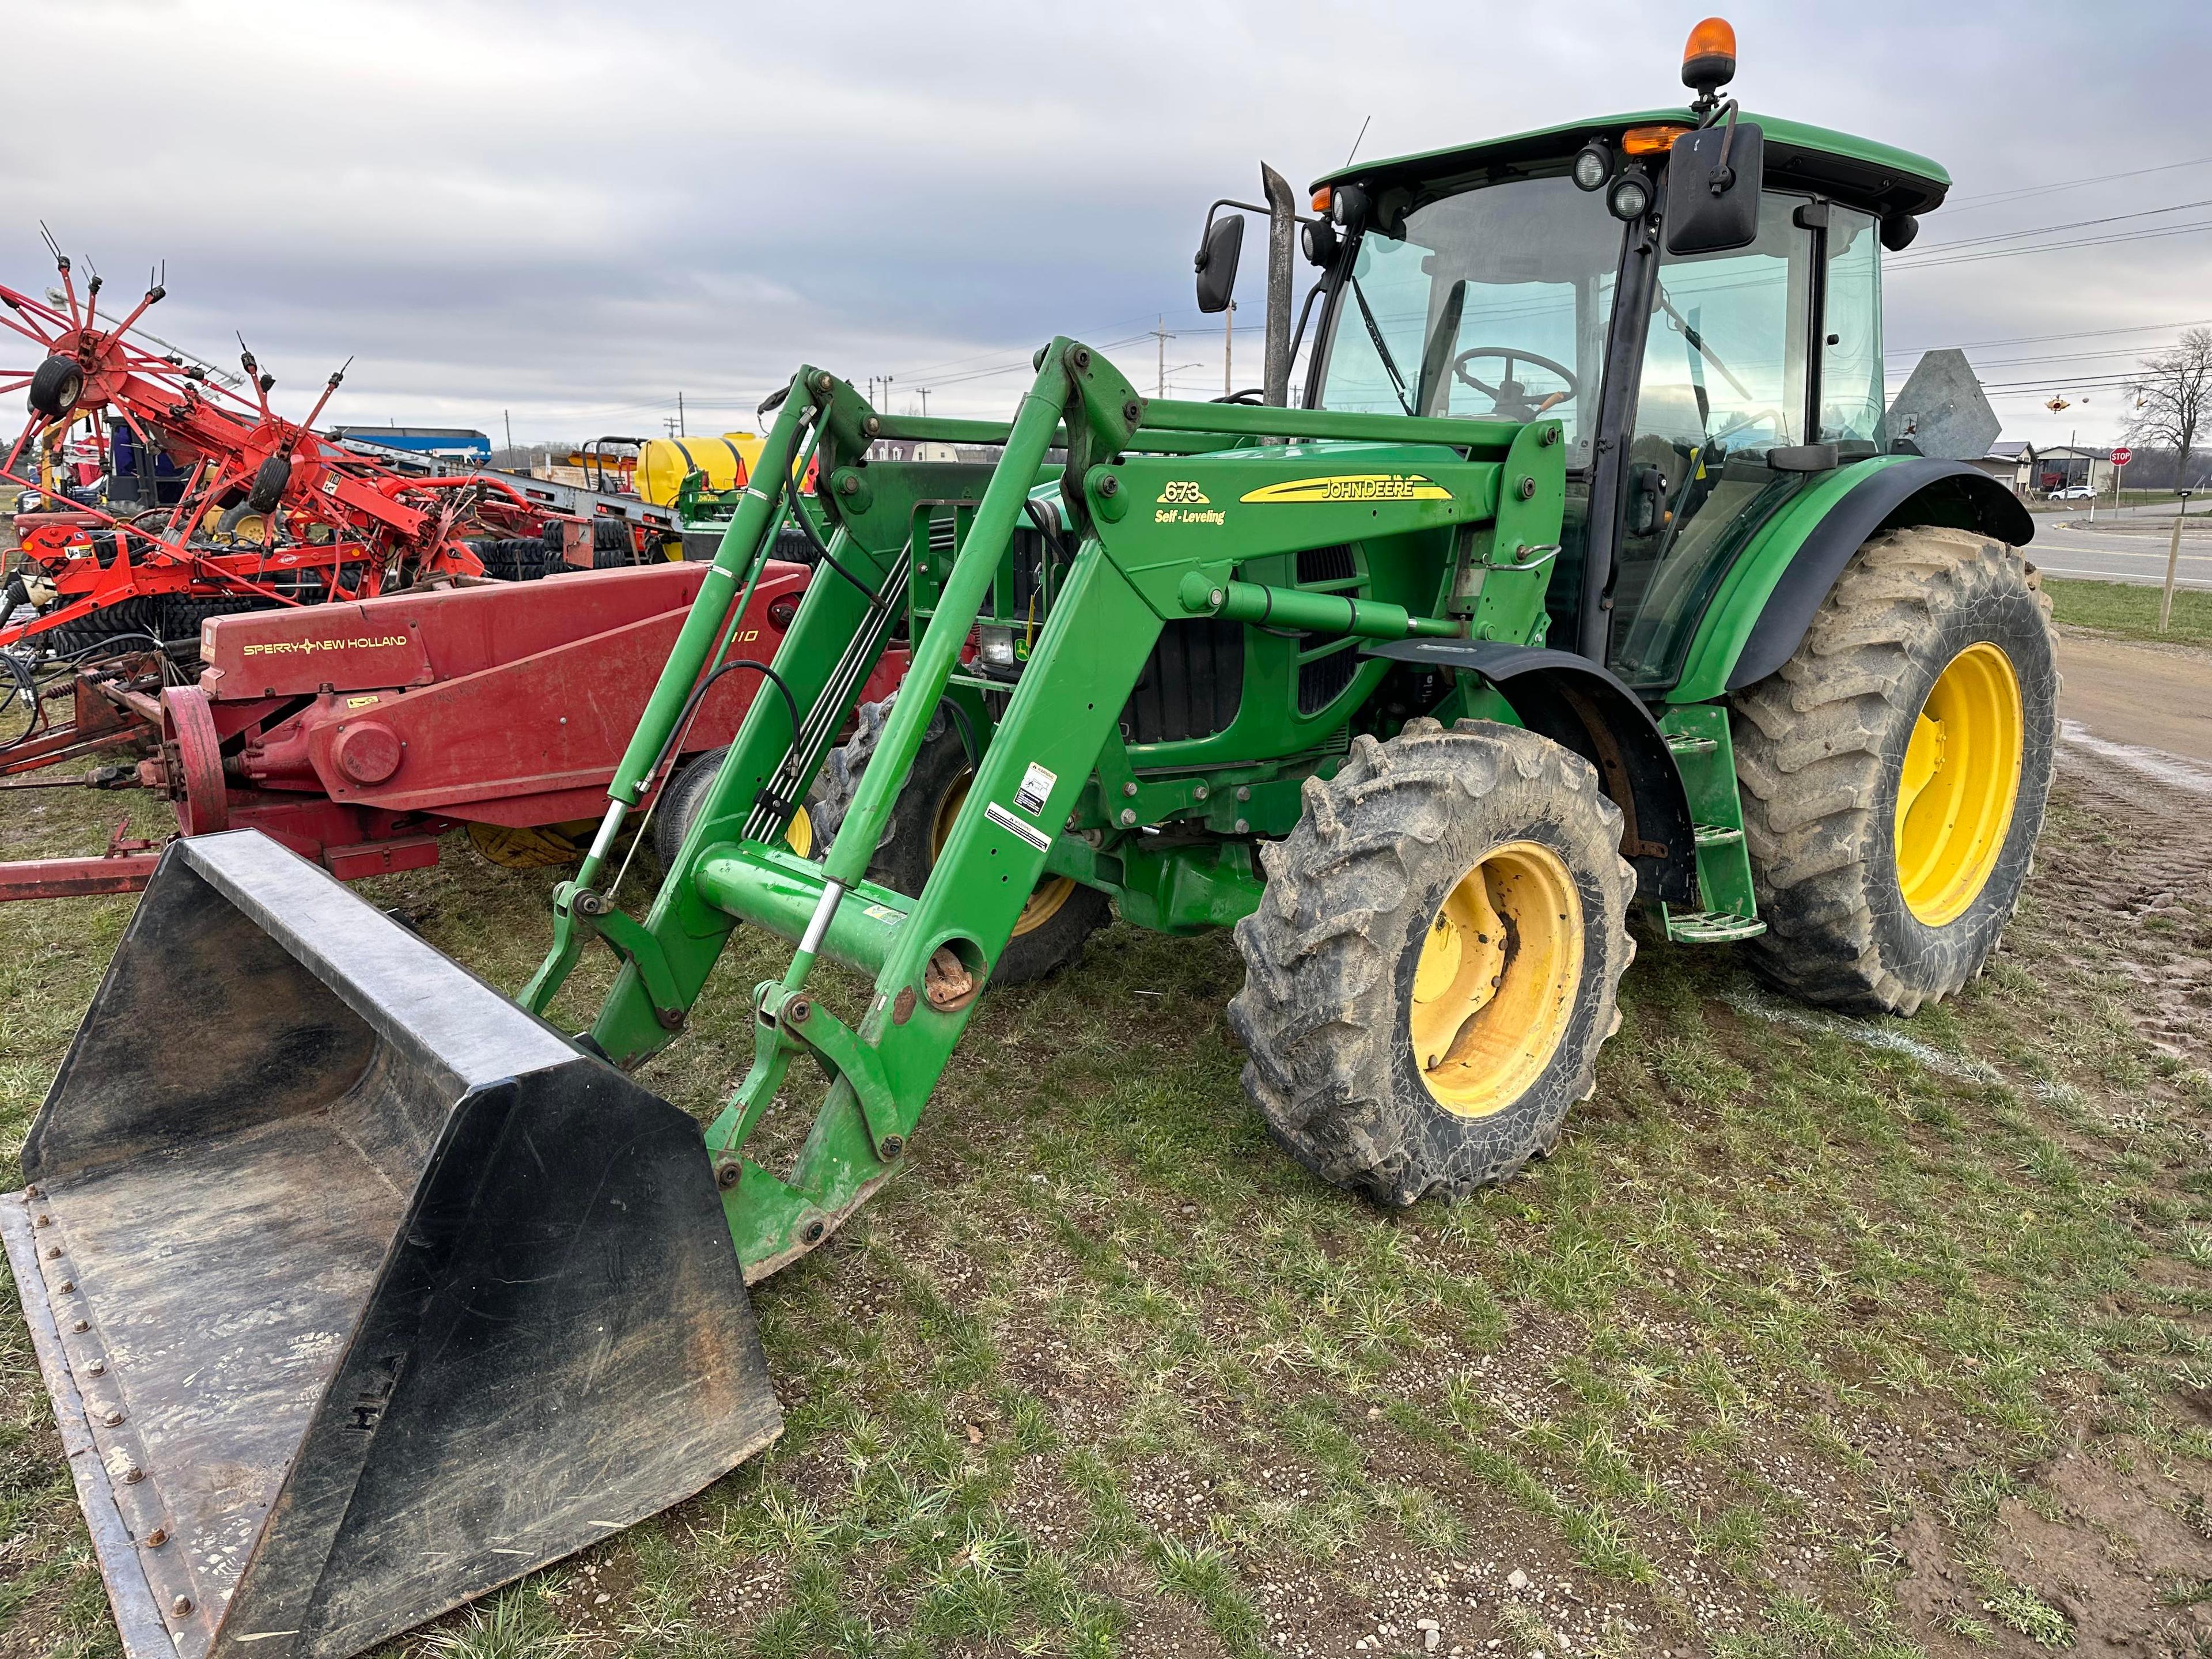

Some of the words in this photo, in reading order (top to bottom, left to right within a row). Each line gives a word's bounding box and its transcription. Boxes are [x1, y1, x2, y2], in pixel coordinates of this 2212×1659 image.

[2111, 452, 2130, 461] STOP
[1165, 481, 1199, 502] 673
[1322, 479, 1362, 498] JOHN
[1364, 479, 1414, 497] DEERE
[244, 642, 299, 656] SPERRY
[316, 639, 345, 650] NEW
[348, 636, 407, 648] HOLLAND
